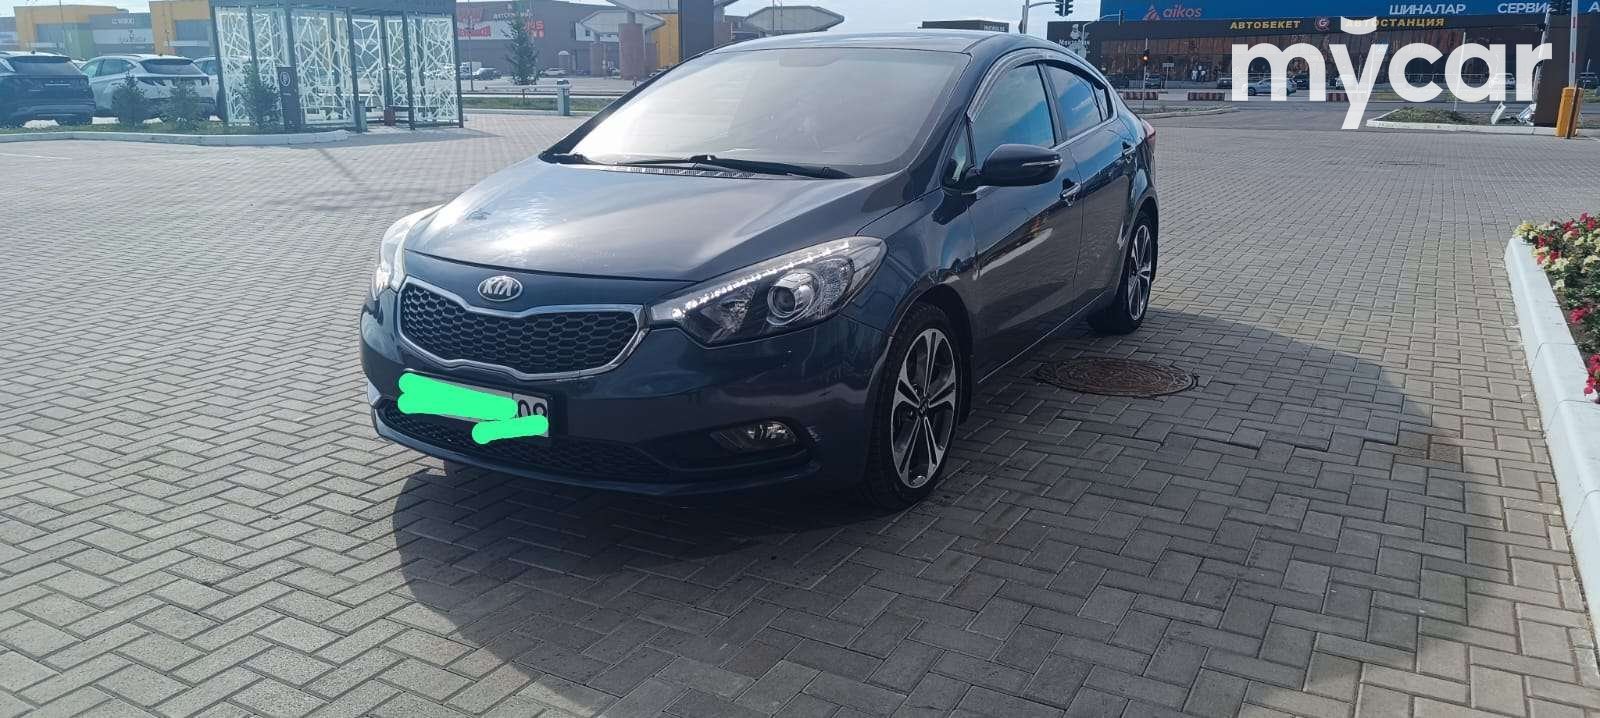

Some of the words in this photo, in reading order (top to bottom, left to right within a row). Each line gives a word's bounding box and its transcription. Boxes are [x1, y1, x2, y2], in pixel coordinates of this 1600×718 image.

[1163, 5, 1202, 19] aikos
[1389, 4, 1467, 15] ШИНАЛАР
[1230, 20, 1301, 30] АВТОБЕКЕТ
[482, 277, 513, 297] KIA
